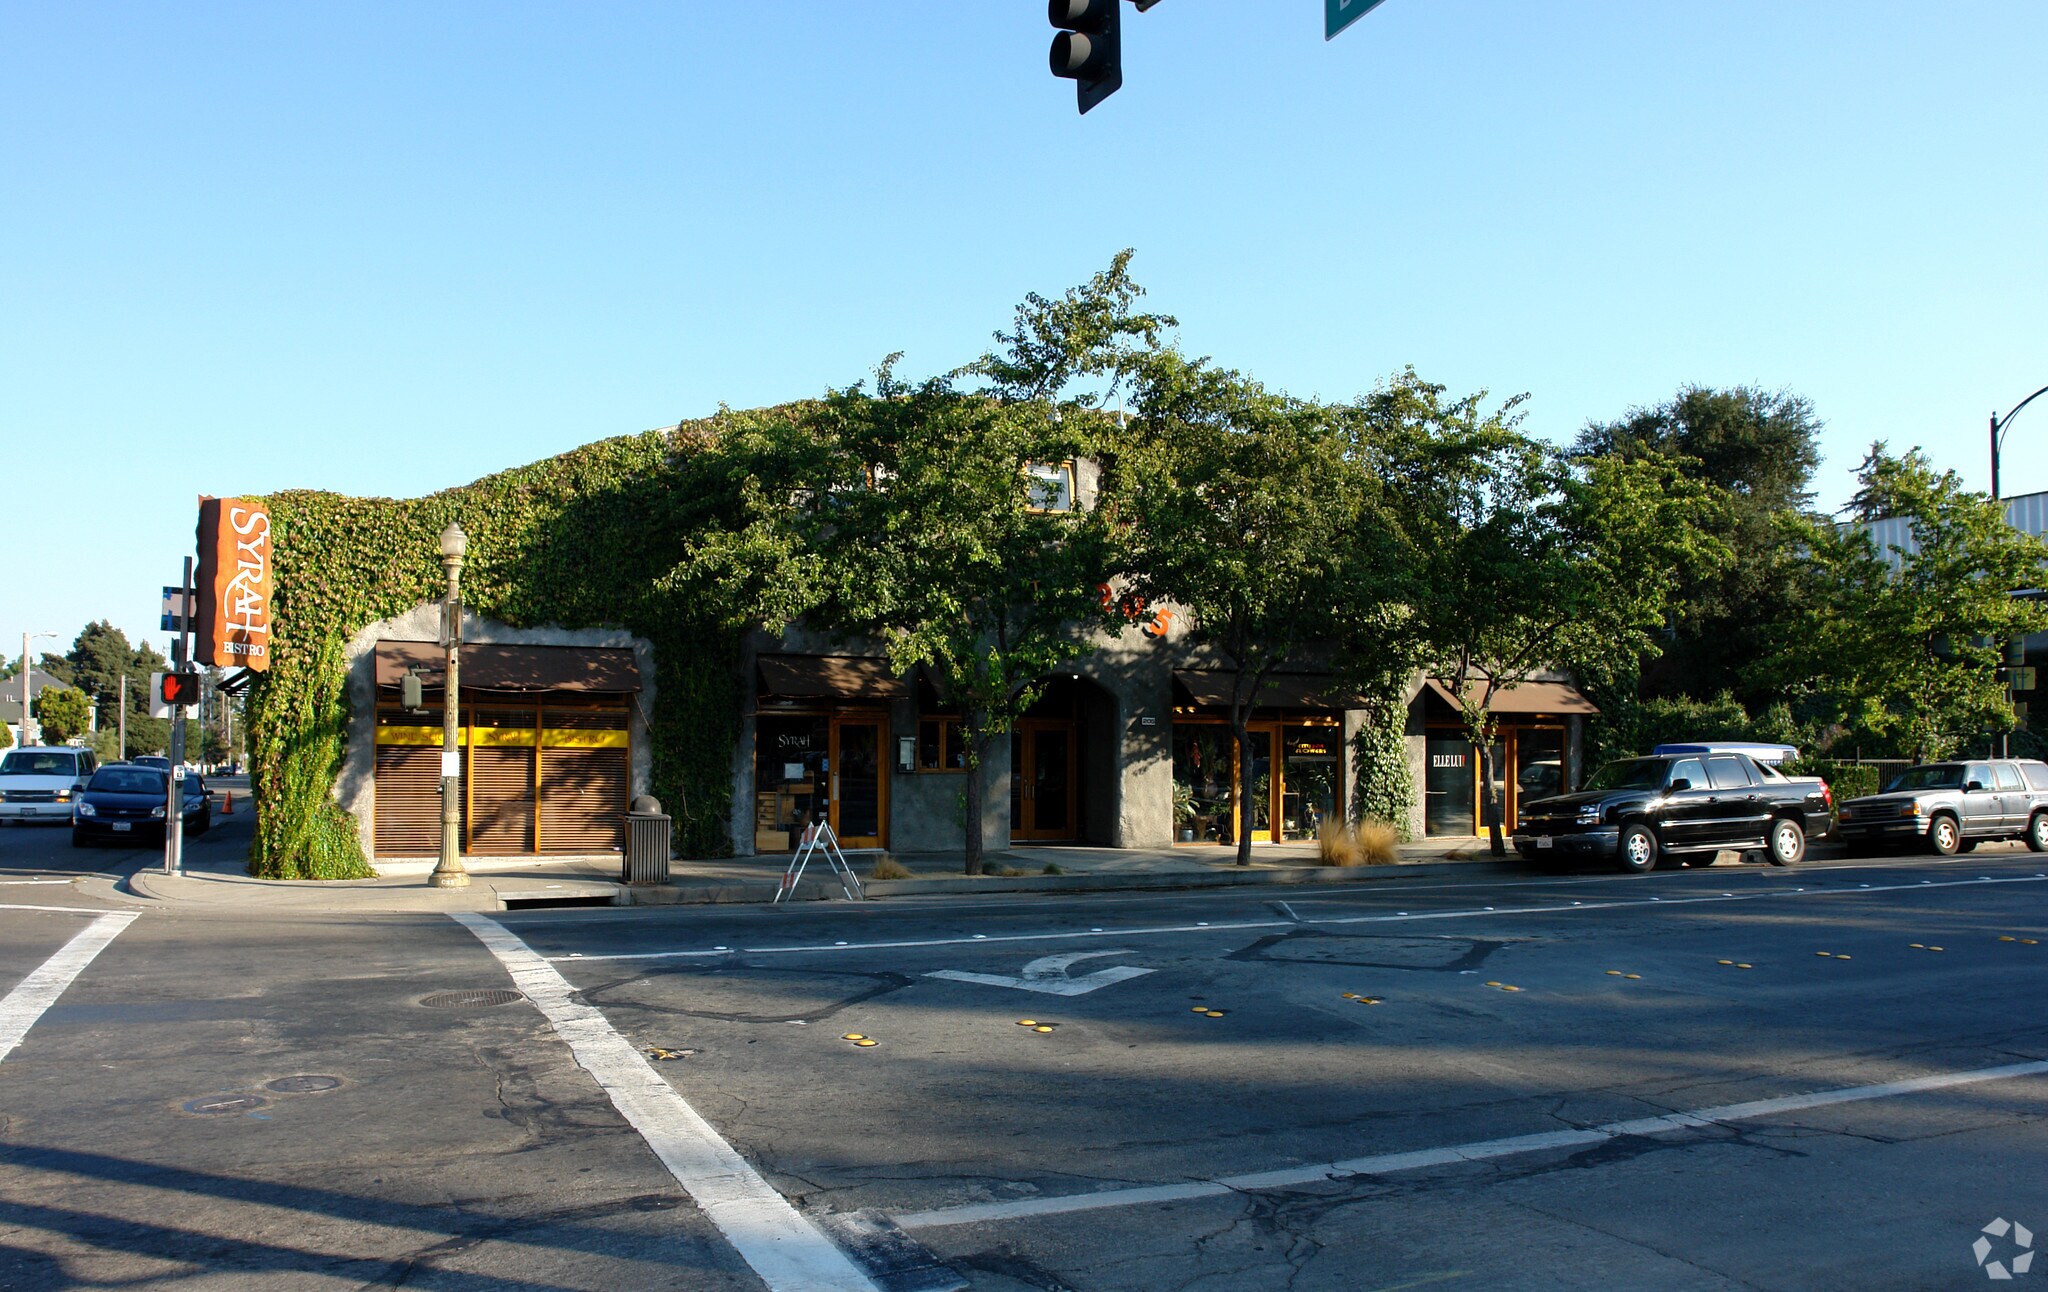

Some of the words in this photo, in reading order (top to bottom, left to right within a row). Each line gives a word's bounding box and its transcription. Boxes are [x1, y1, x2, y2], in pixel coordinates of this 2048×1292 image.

[224, 507, 269, 642] SYRAH
[223, 641, 265, 658] BISTRO
[778, 734, 810, 749] SYRAH
[1433, 754, 1450, 768] ELLE
